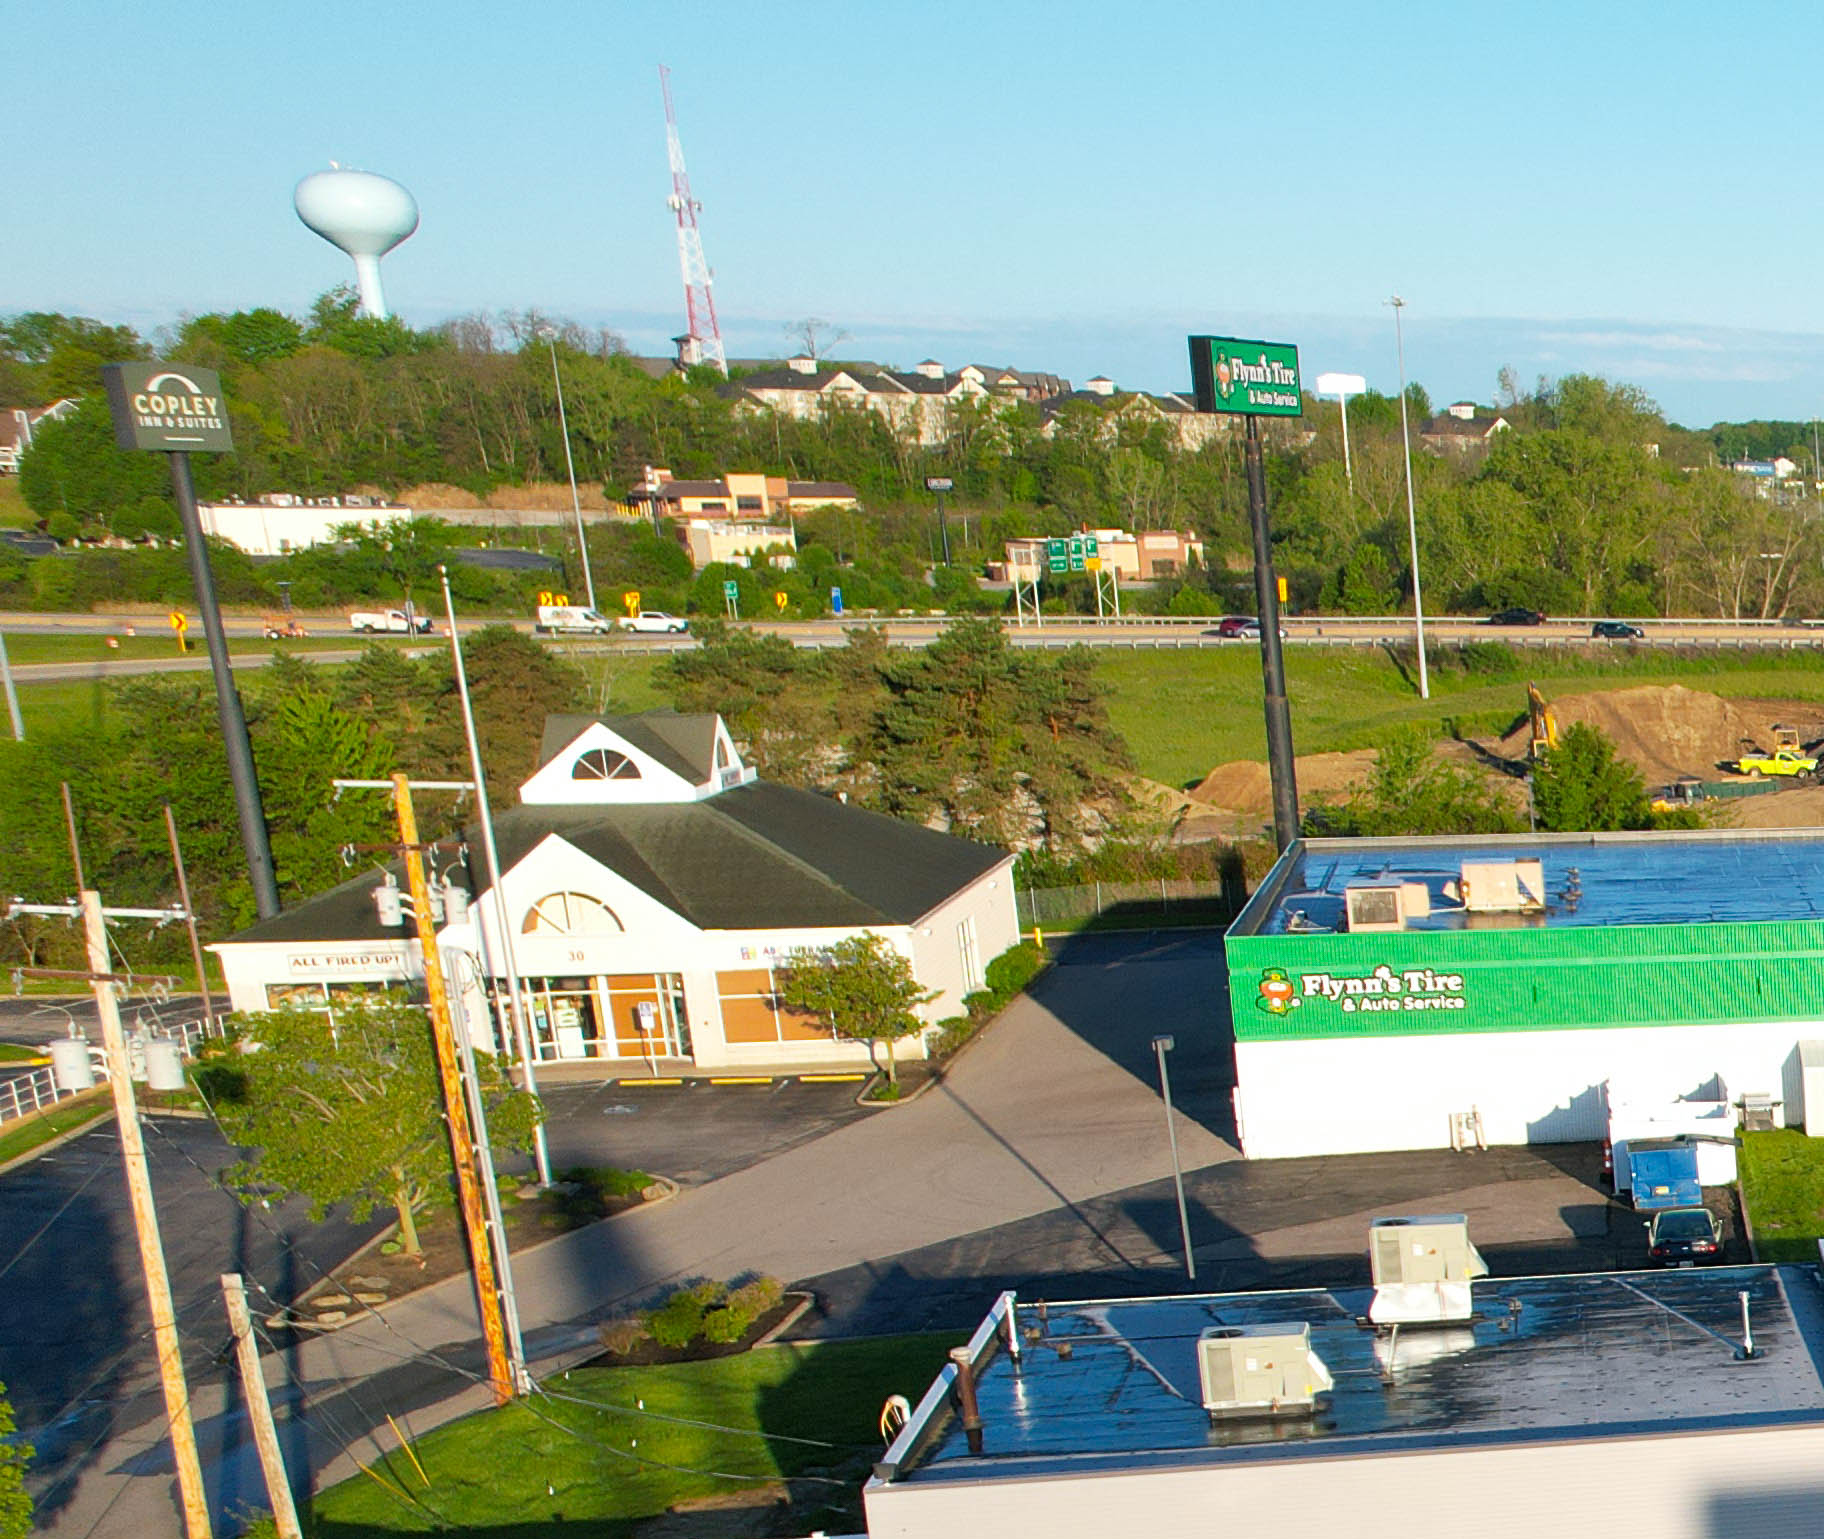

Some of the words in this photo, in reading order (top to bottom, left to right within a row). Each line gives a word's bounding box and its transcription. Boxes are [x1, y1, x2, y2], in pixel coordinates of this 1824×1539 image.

[1231, 353, 1272, 388] Flynn's
[1271, 360, 1296, 385] Tire
[134, 394, 217, 416] COPLEY
[1257, 390, 1273, 405] Auto
[1273, 391, 1298, 407] Service
[138, 415, 162, 427] INN
[177, 417, 222, 429] SUITES
[293, 957, 319, 967] ALL
[325, 955, 371, 966] FIRED
[1301, 966, 1402, 1001] Flynn's
[1403, 968, 1464, 993] Tire
[1342, 998, 1356, 1012] &
[1360, 997, 1400, 1011] Auto
[1402, 995, 1465, 1011] Service
